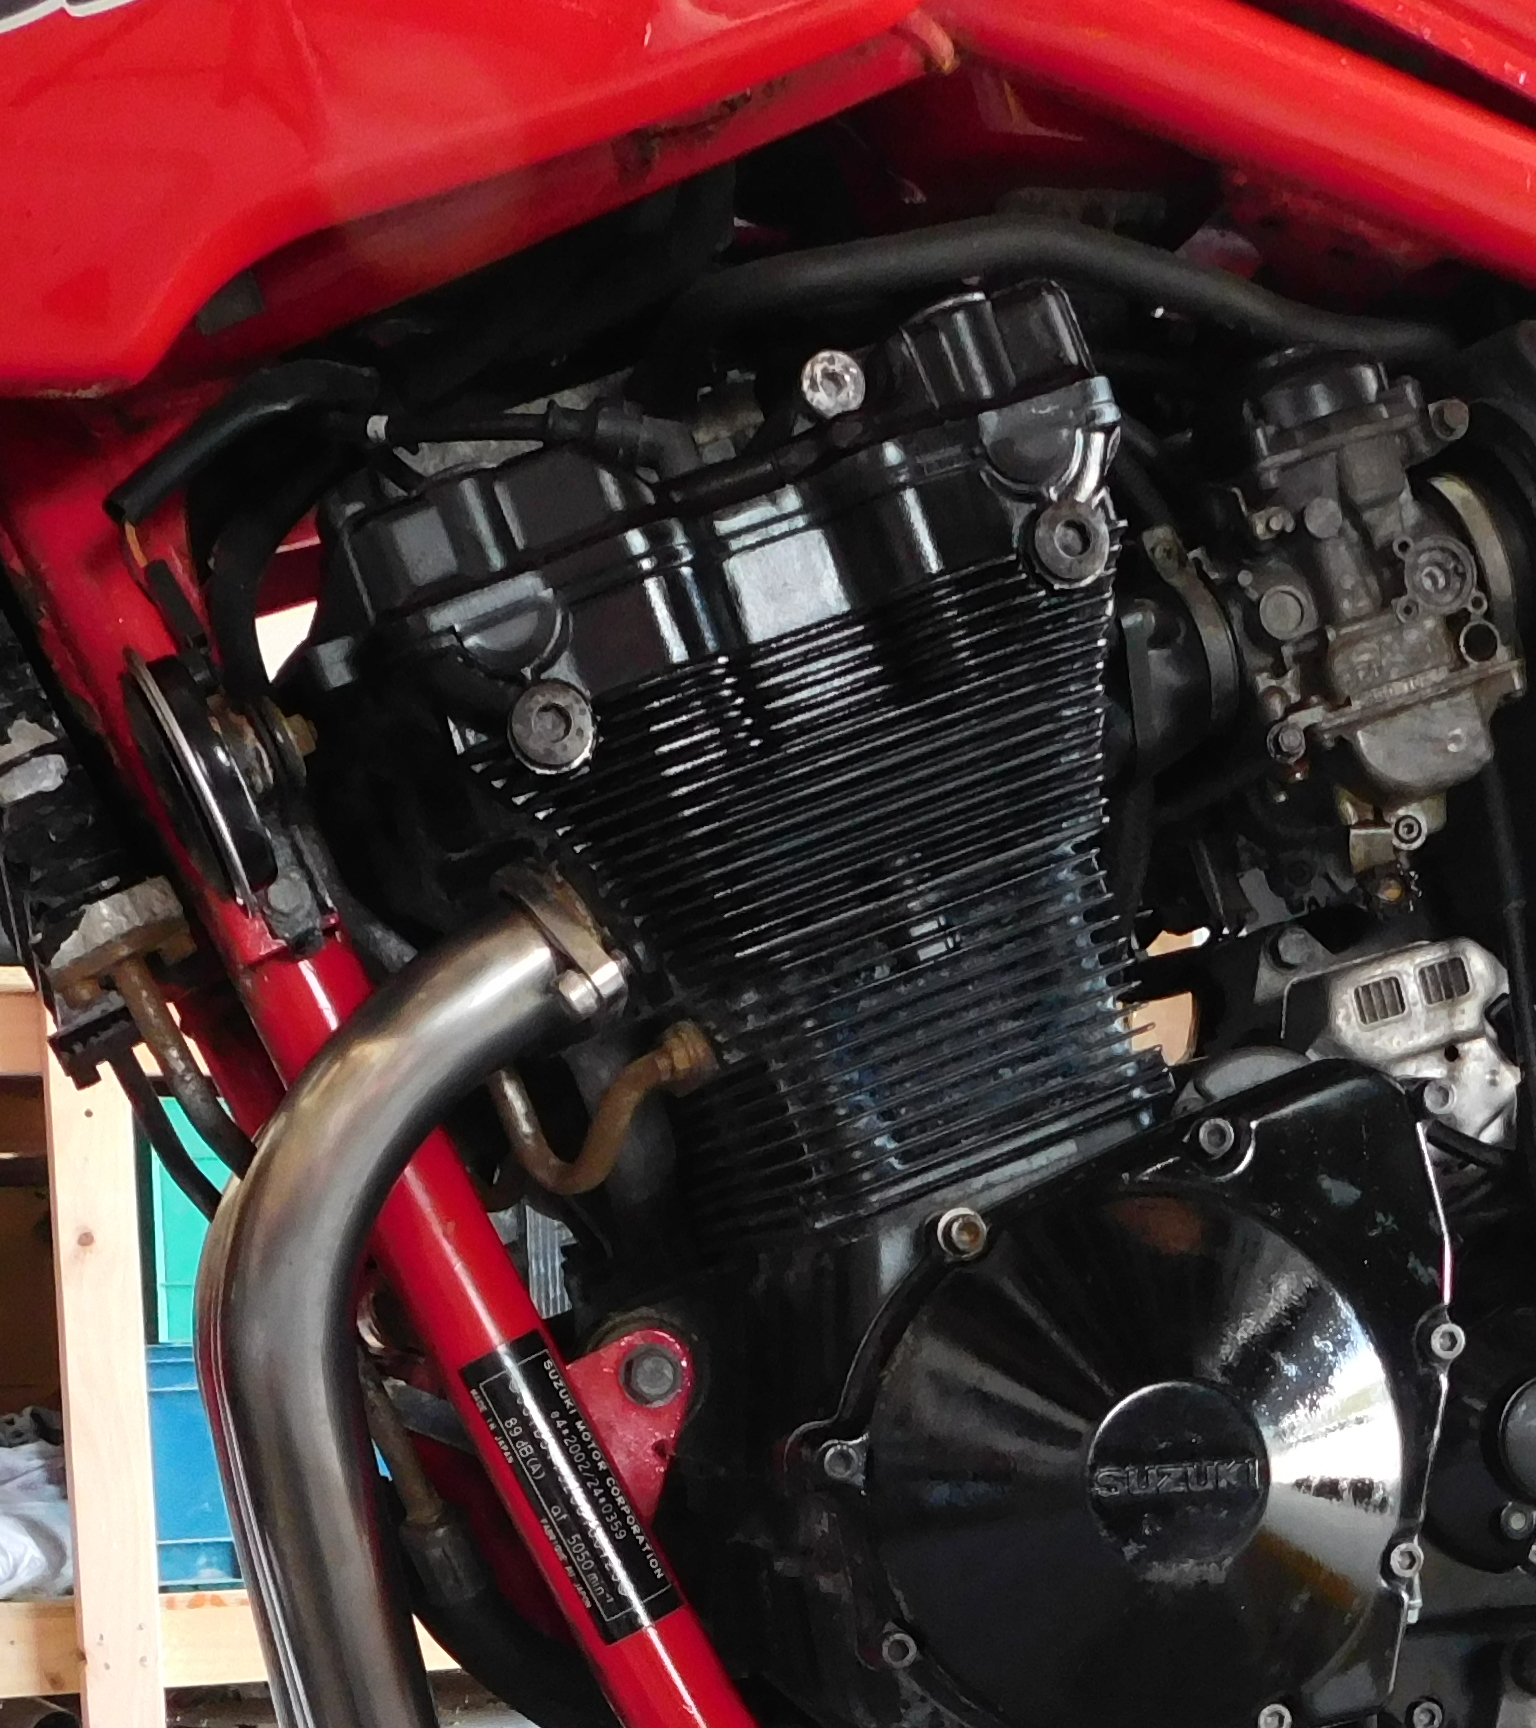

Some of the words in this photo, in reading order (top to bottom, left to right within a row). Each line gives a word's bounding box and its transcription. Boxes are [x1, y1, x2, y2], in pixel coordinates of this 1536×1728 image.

[540, 1358, 578, 1416] SUZUKI
[572, 1418, 608, 1473] MOTOR
[603, 1475, 665, 1580] CORPORATION
[1092, 1457, 1262, 1498] SUZUKI
[548, 1502, 568, 1524] at
[564, 1531, 596, 1573] 5050
